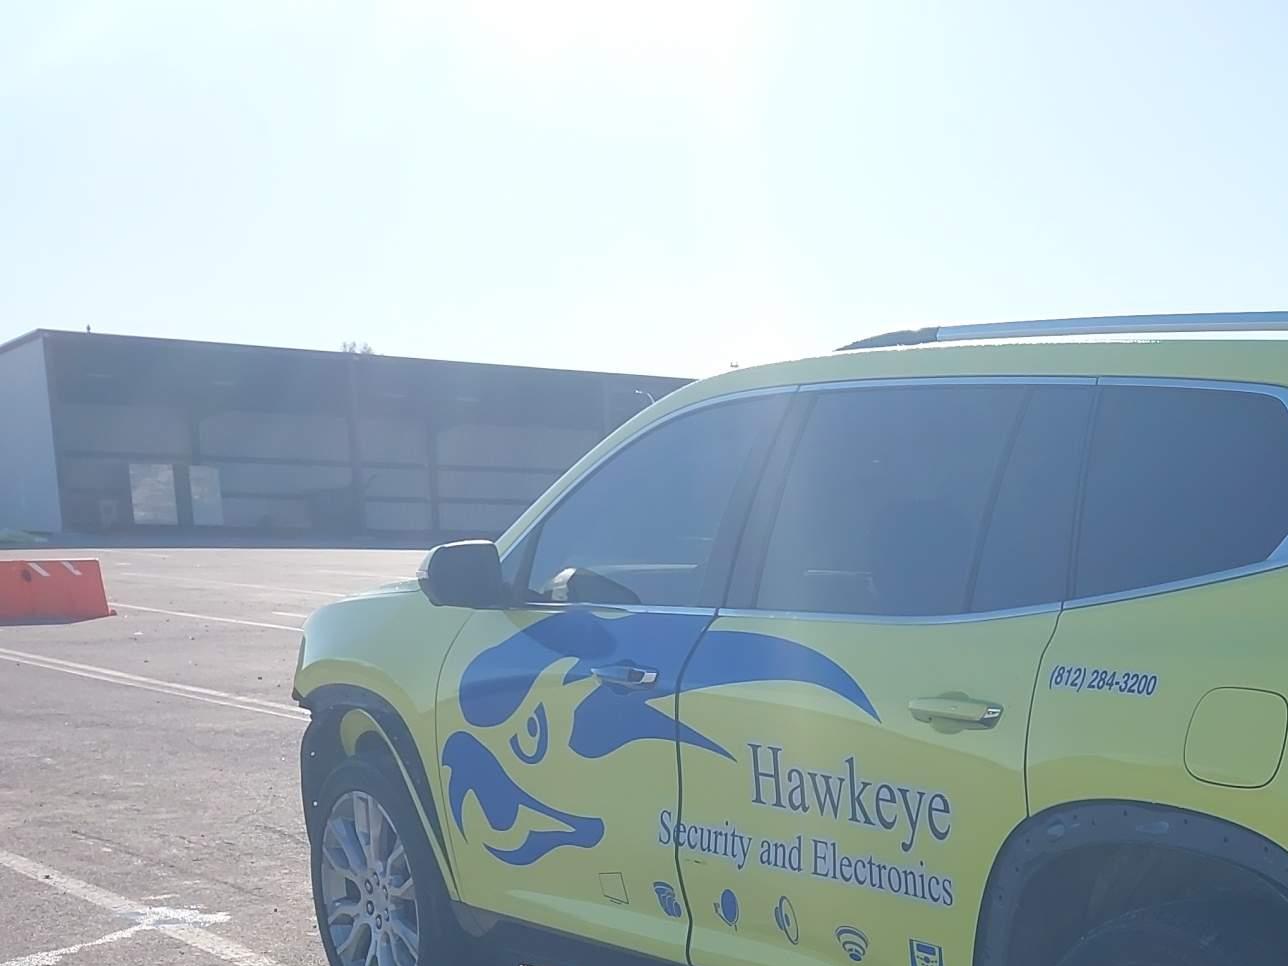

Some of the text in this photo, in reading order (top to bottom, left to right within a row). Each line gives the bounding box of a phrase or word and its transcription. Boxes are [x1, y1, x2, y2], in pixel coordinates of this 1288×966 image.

[1049, 665, 1157, 696] (812) 284-3200
[747, 743, 951, 852] Hawkeye
[658, 810, 953, 906] Security and Electronics
